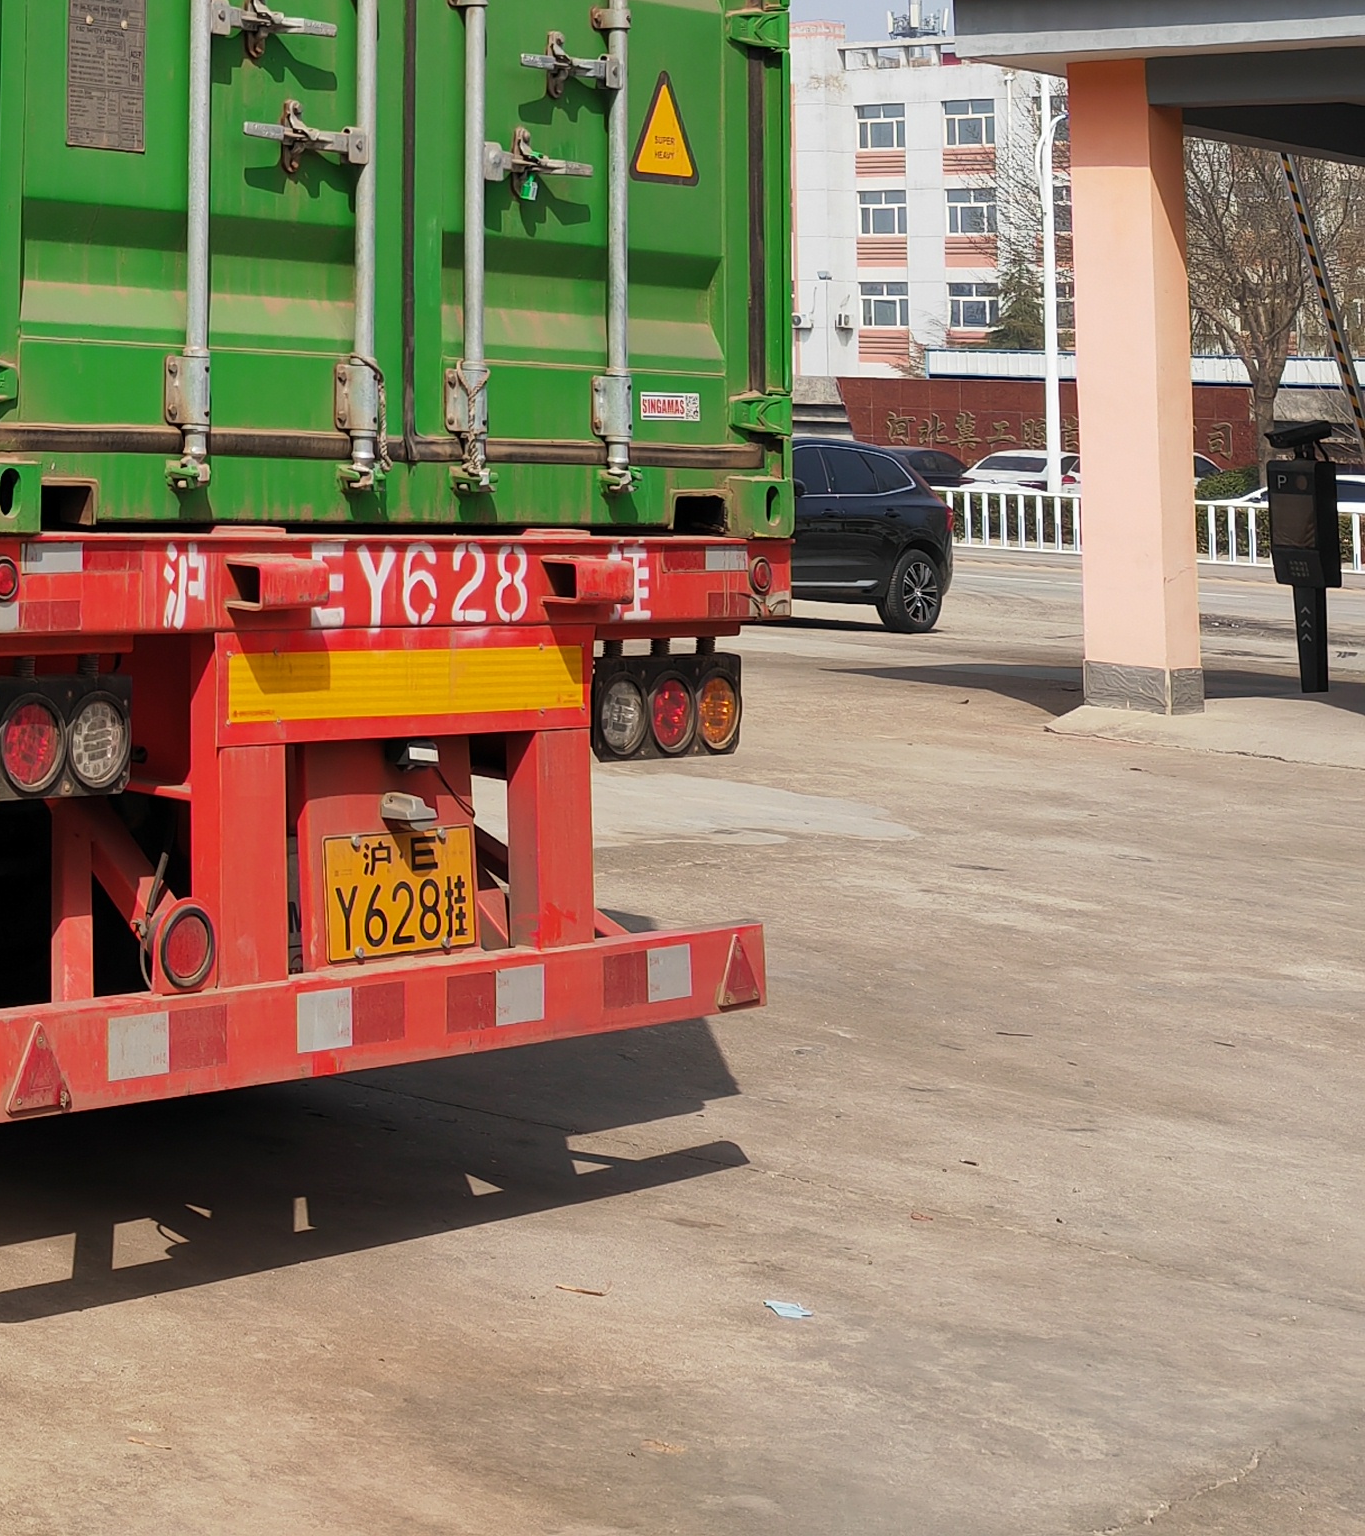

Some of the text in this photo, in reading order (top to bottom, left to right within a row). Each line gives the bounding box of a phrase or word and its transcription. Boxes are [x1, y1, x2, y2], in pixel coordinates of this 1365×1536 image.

[654, 135, 675, 145] SUPER
[654, 151, 675, 160] HEAVY
[642, 398, 685, 414] SINGAMAS
[1277, 475, 1287, 489] P
